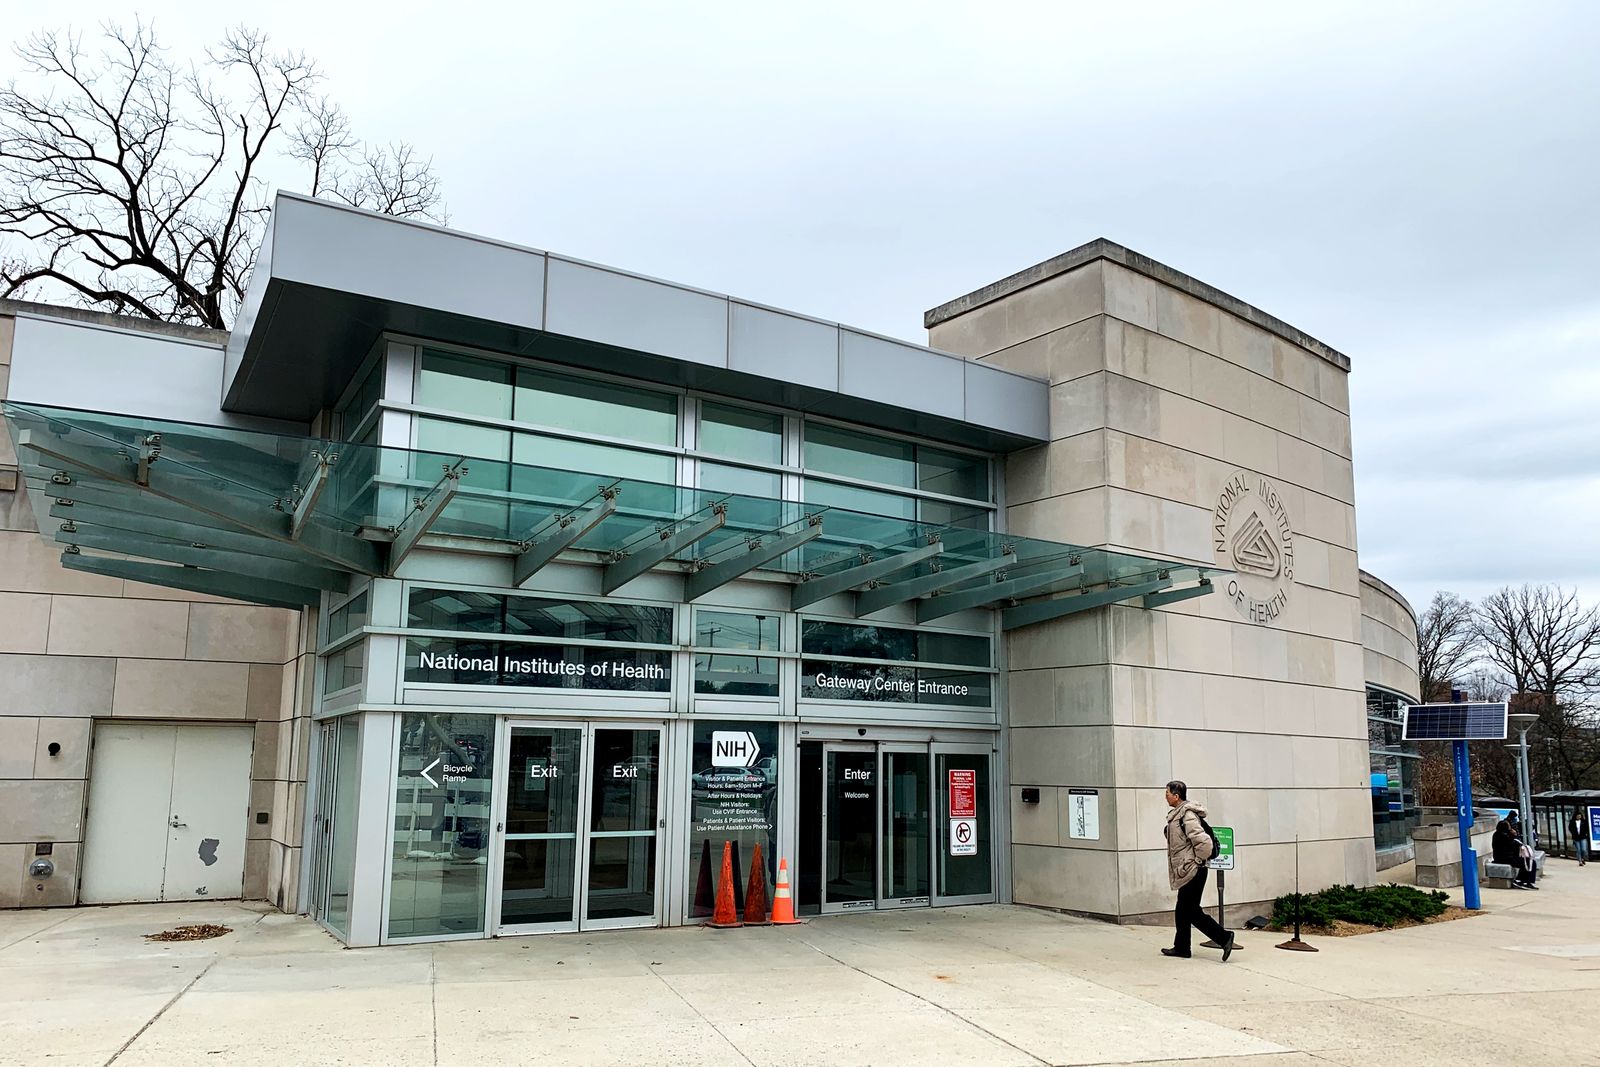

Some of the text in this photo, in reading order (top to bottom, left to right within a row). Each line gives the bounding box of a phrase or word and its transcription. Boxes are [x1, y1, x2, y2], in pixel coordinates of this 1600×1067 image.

[1215, 474, 1294, 580] NATIONAL INSTITUTES
[1228, 580, 1288, 624] OF HEALTH
[420, 652, 664, 679] National Institutes of Health
[816, 672, 968, 696] Gateway Center Entrance
[716, 740, 746, 757] NIH
[443, 764, 472, 774] Bicycle
[531, 765, 558, 778] Exit
[613, 765, 638, 778] Exit
[844, 768, 871, 780] Enter
[442, 775, 466, 783] Ramp
